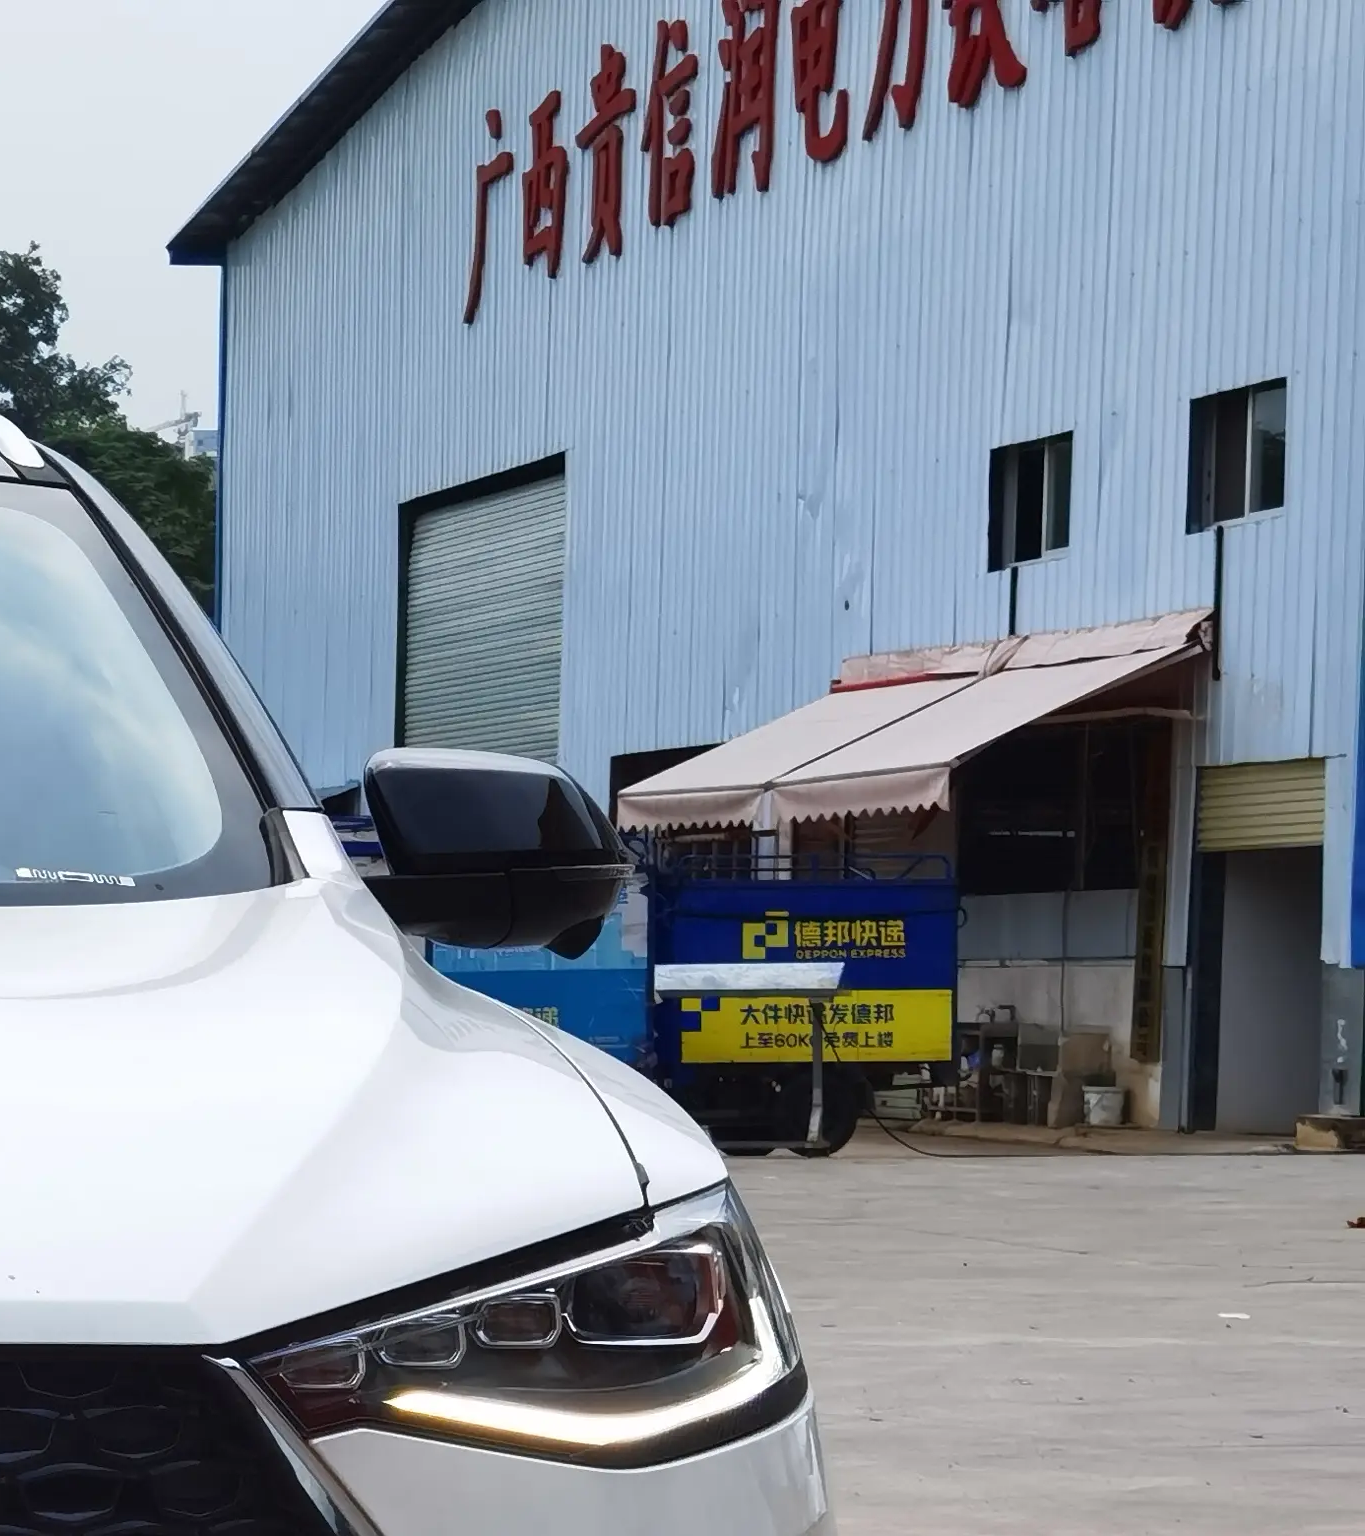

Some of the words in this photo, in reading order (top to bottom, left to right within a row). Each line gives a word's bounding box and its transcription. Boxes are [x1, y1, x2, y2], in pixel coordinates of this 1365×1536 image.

[463, 0, 1247, 325] 广西贵信润电力
[794, 919, 906, 947] 德邦快递
[795, 949, 847, 959] DEPPON
[850, 948, 906, 958] EXPRESS
